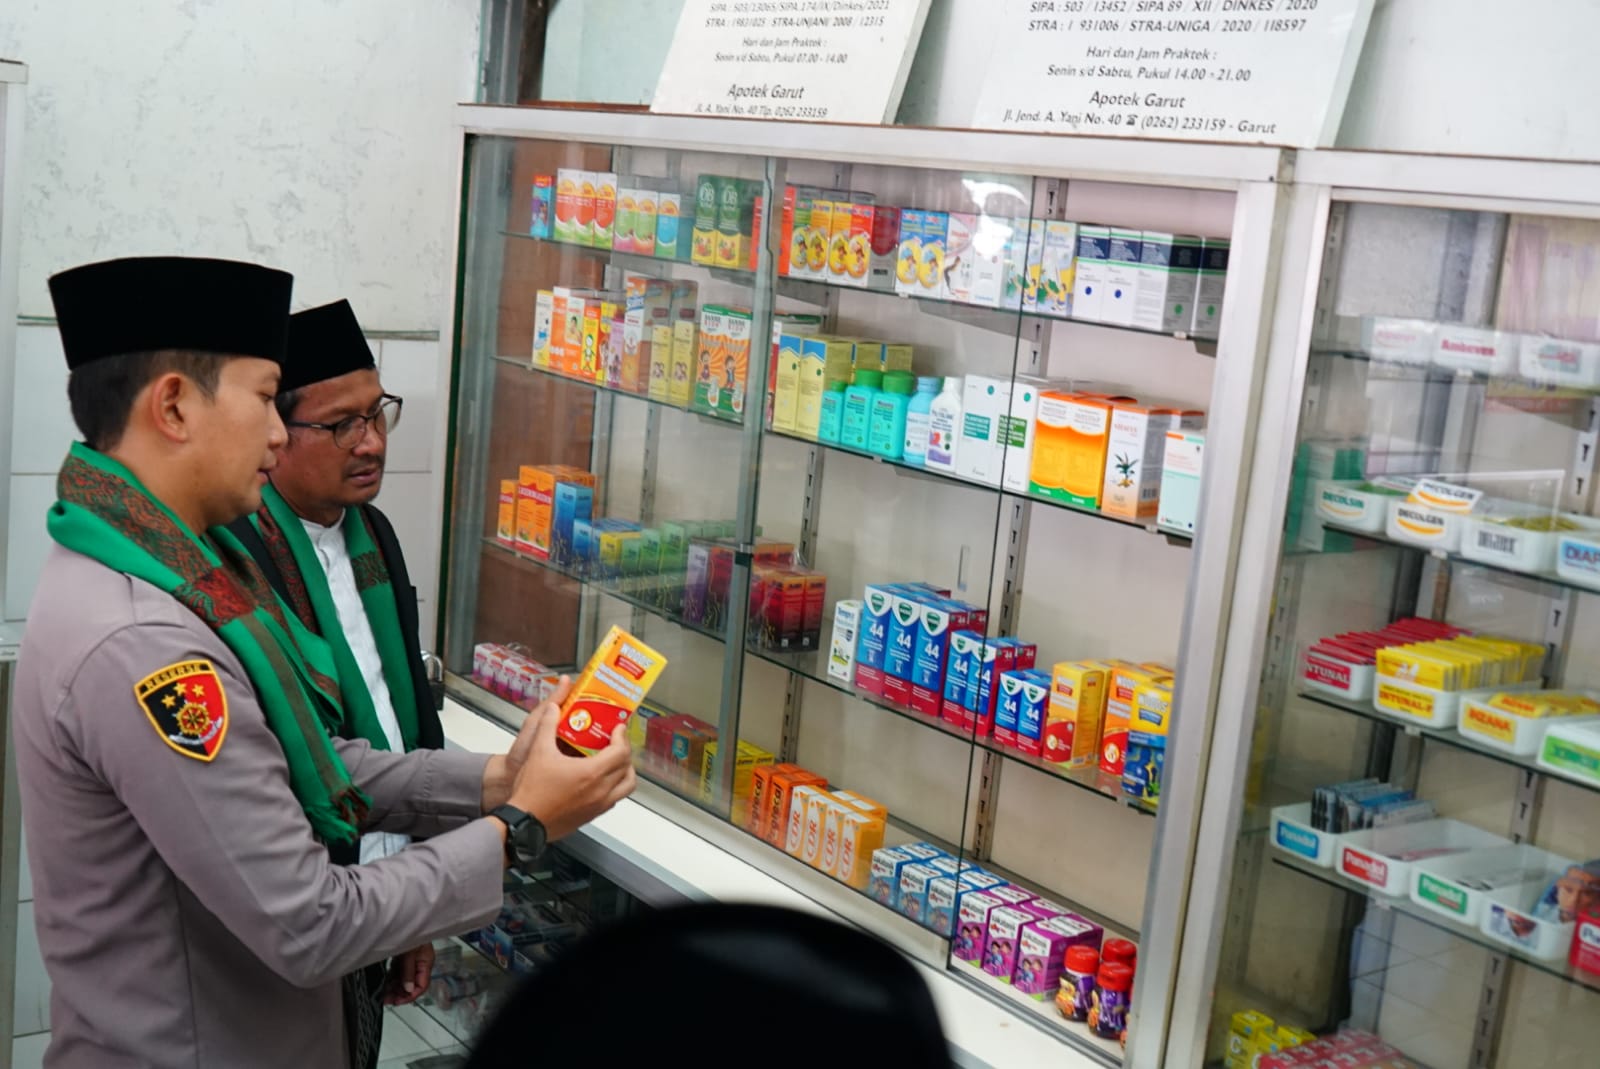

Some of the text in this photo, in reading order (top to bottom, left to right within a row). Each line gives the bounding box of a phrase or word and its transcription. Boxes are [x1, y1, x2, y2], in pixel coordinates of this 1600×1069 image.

[1030, 1, 1055, 13] SIPA
[1063, 1, 1083, 12] 503
[1136, 1, 1165, 12] SIPA
[1222, 0, 1275, 11] DINKES
[1028, 20, 1058, 31] STRA
[1222, 20, 1252, 32] 2020
[1086, 46, 1111, 59] Hari
[1113, 47, 1134, 59] dan
[1136, 47, 1160, 61] Jam
[1163, 47, 1210, 60] Praktek
[1047, 64, 1077, 77] Senin
[1137, 66, 1171, 79] Pukul
[1174, 67, 1206, 80] 14.00
[1217, 68, 1251, 82] 21.00
[727, 83, 805, 101] Apotek Garut
[1088, 90, 1186, 108] Apotek Garut
[1108, 114, 1122, 125] 40
[1141, 115, 1178, 131] (0262)
[1182, 117, 1226, 132] 233159
[1237, 121, 1276, 134] Garut
[1397, 508, 1445, 527] DECOLGEN
[870, 622, 884, 639] 44
[896, 632, 912, 649] 44
[924, 643, 940, 659] 44
[954, 657, 968, 675] 44
[1004, 699, 1017, 713] 44
[1026, 707, 1040, 722] 44
